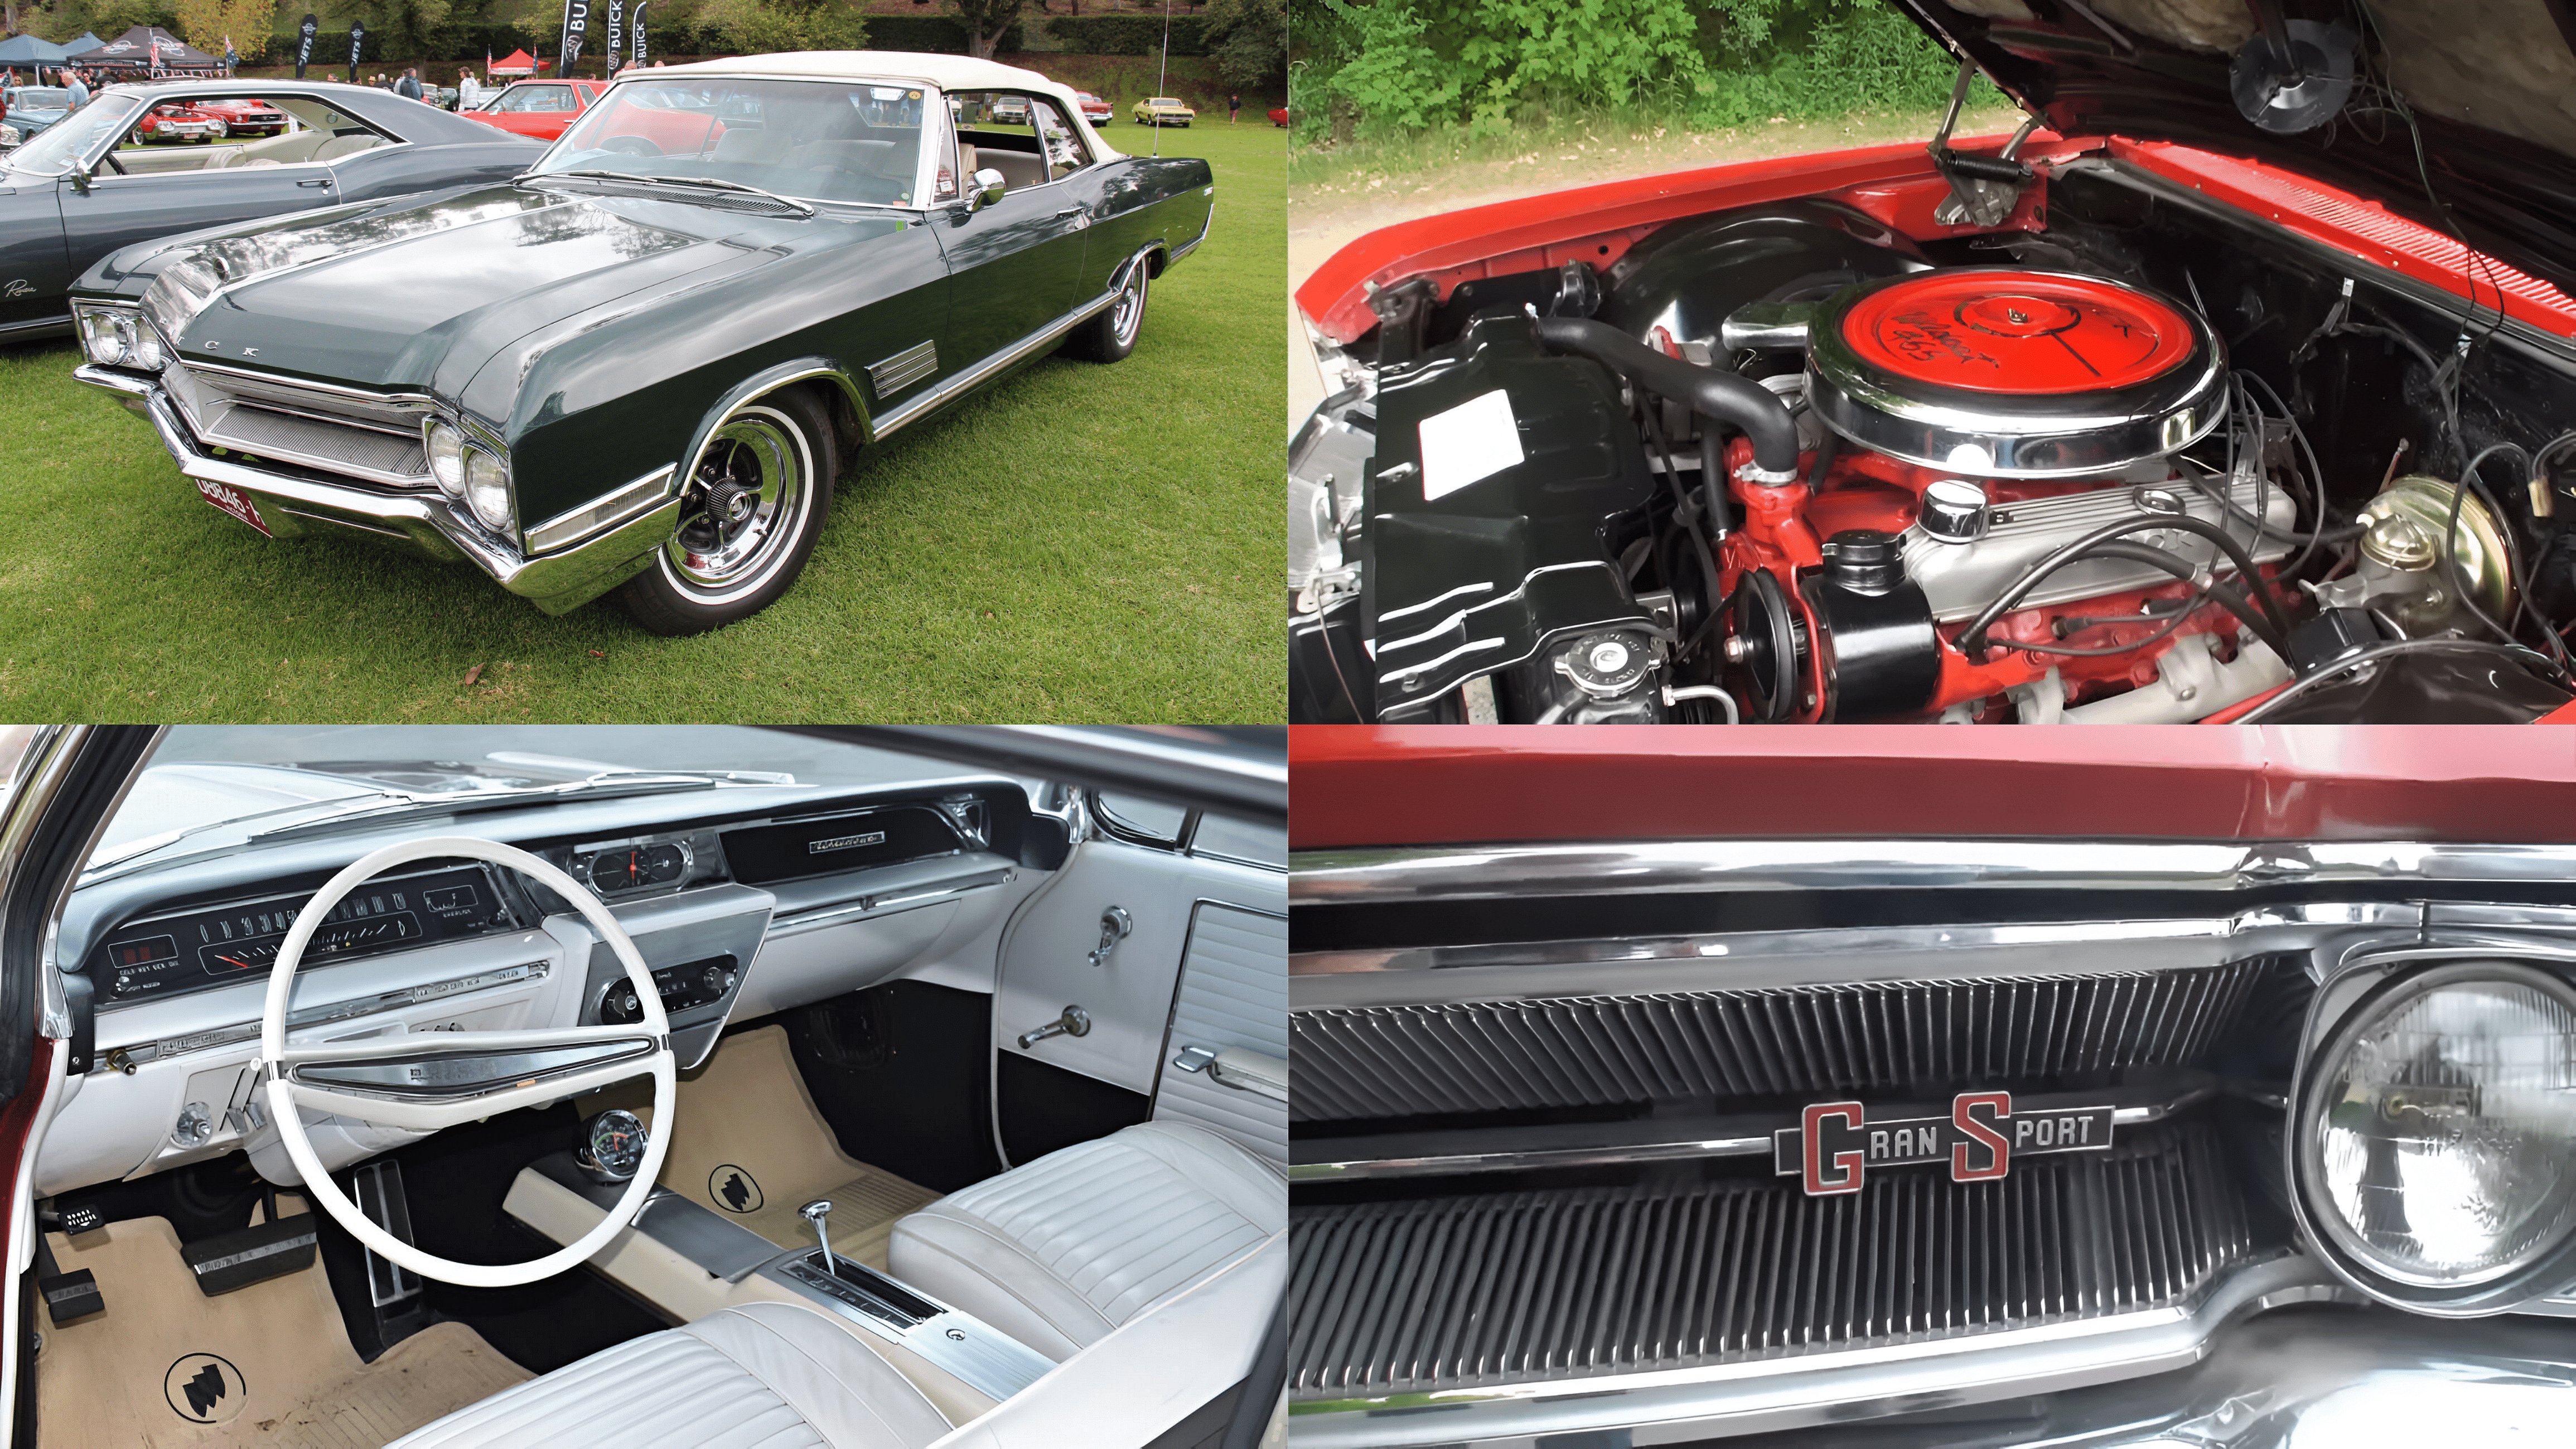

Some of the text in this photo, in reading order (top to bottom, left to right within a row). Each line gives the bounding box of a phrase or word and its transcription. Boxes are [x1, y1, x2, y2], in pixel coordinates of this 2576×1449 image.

[570, 0, 587, 31] BU
[611, 1, 622, 48] BUICK
[300, 36, 312, 63] JETS
[351, 41, 360, 64] JETS
[636, 22, 647, 58] BUICK
[225, 504, 249, 521] VICTORIA
[1801, 1090, 2094, 1197] GRAN SPORT
